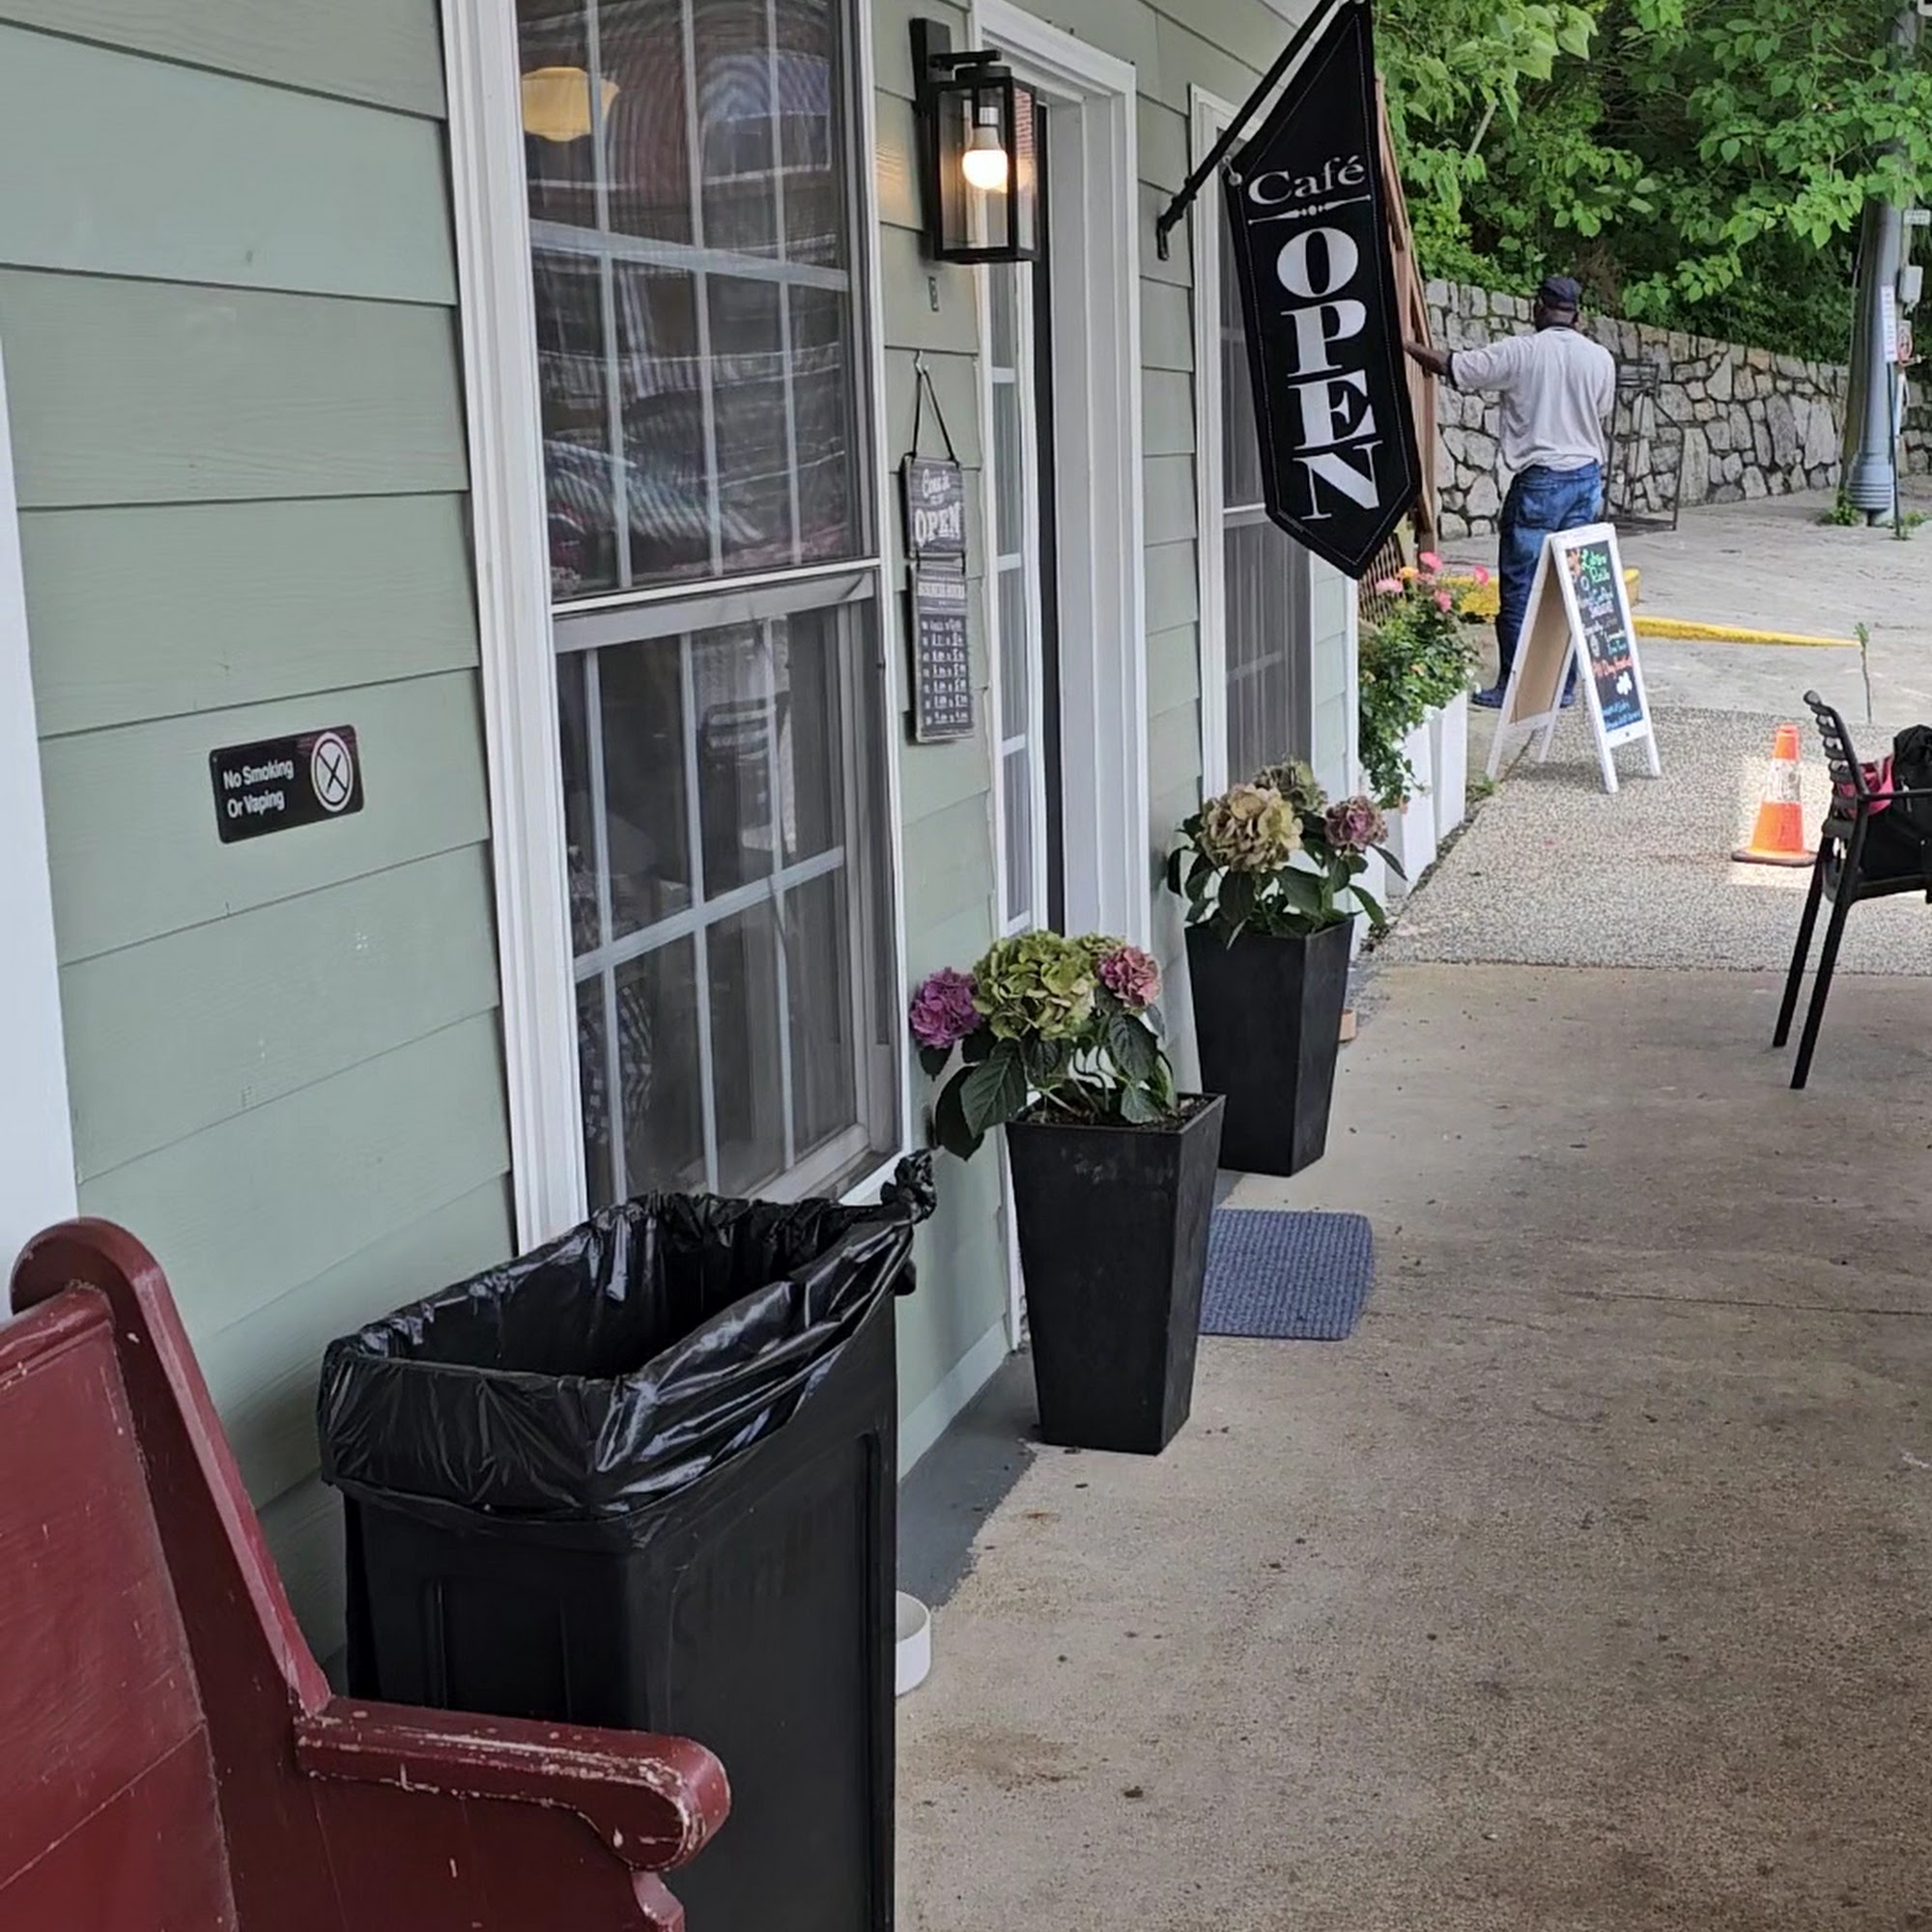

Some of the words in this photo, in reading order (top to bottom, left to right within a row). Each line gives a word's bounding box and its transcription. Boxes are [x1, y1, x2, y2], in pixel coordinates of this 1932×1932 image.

[1248, 155, 1366, 206] Café
[1276, 226, 1383, 522] OPEN
[915, 500, 961, 548] OPEN
[223, 770, 242, 790] No
[242, 759, 294, 785] Smoking
[227, 799, 243, 818] Or
[243, 790, 285, 815] Vaping
